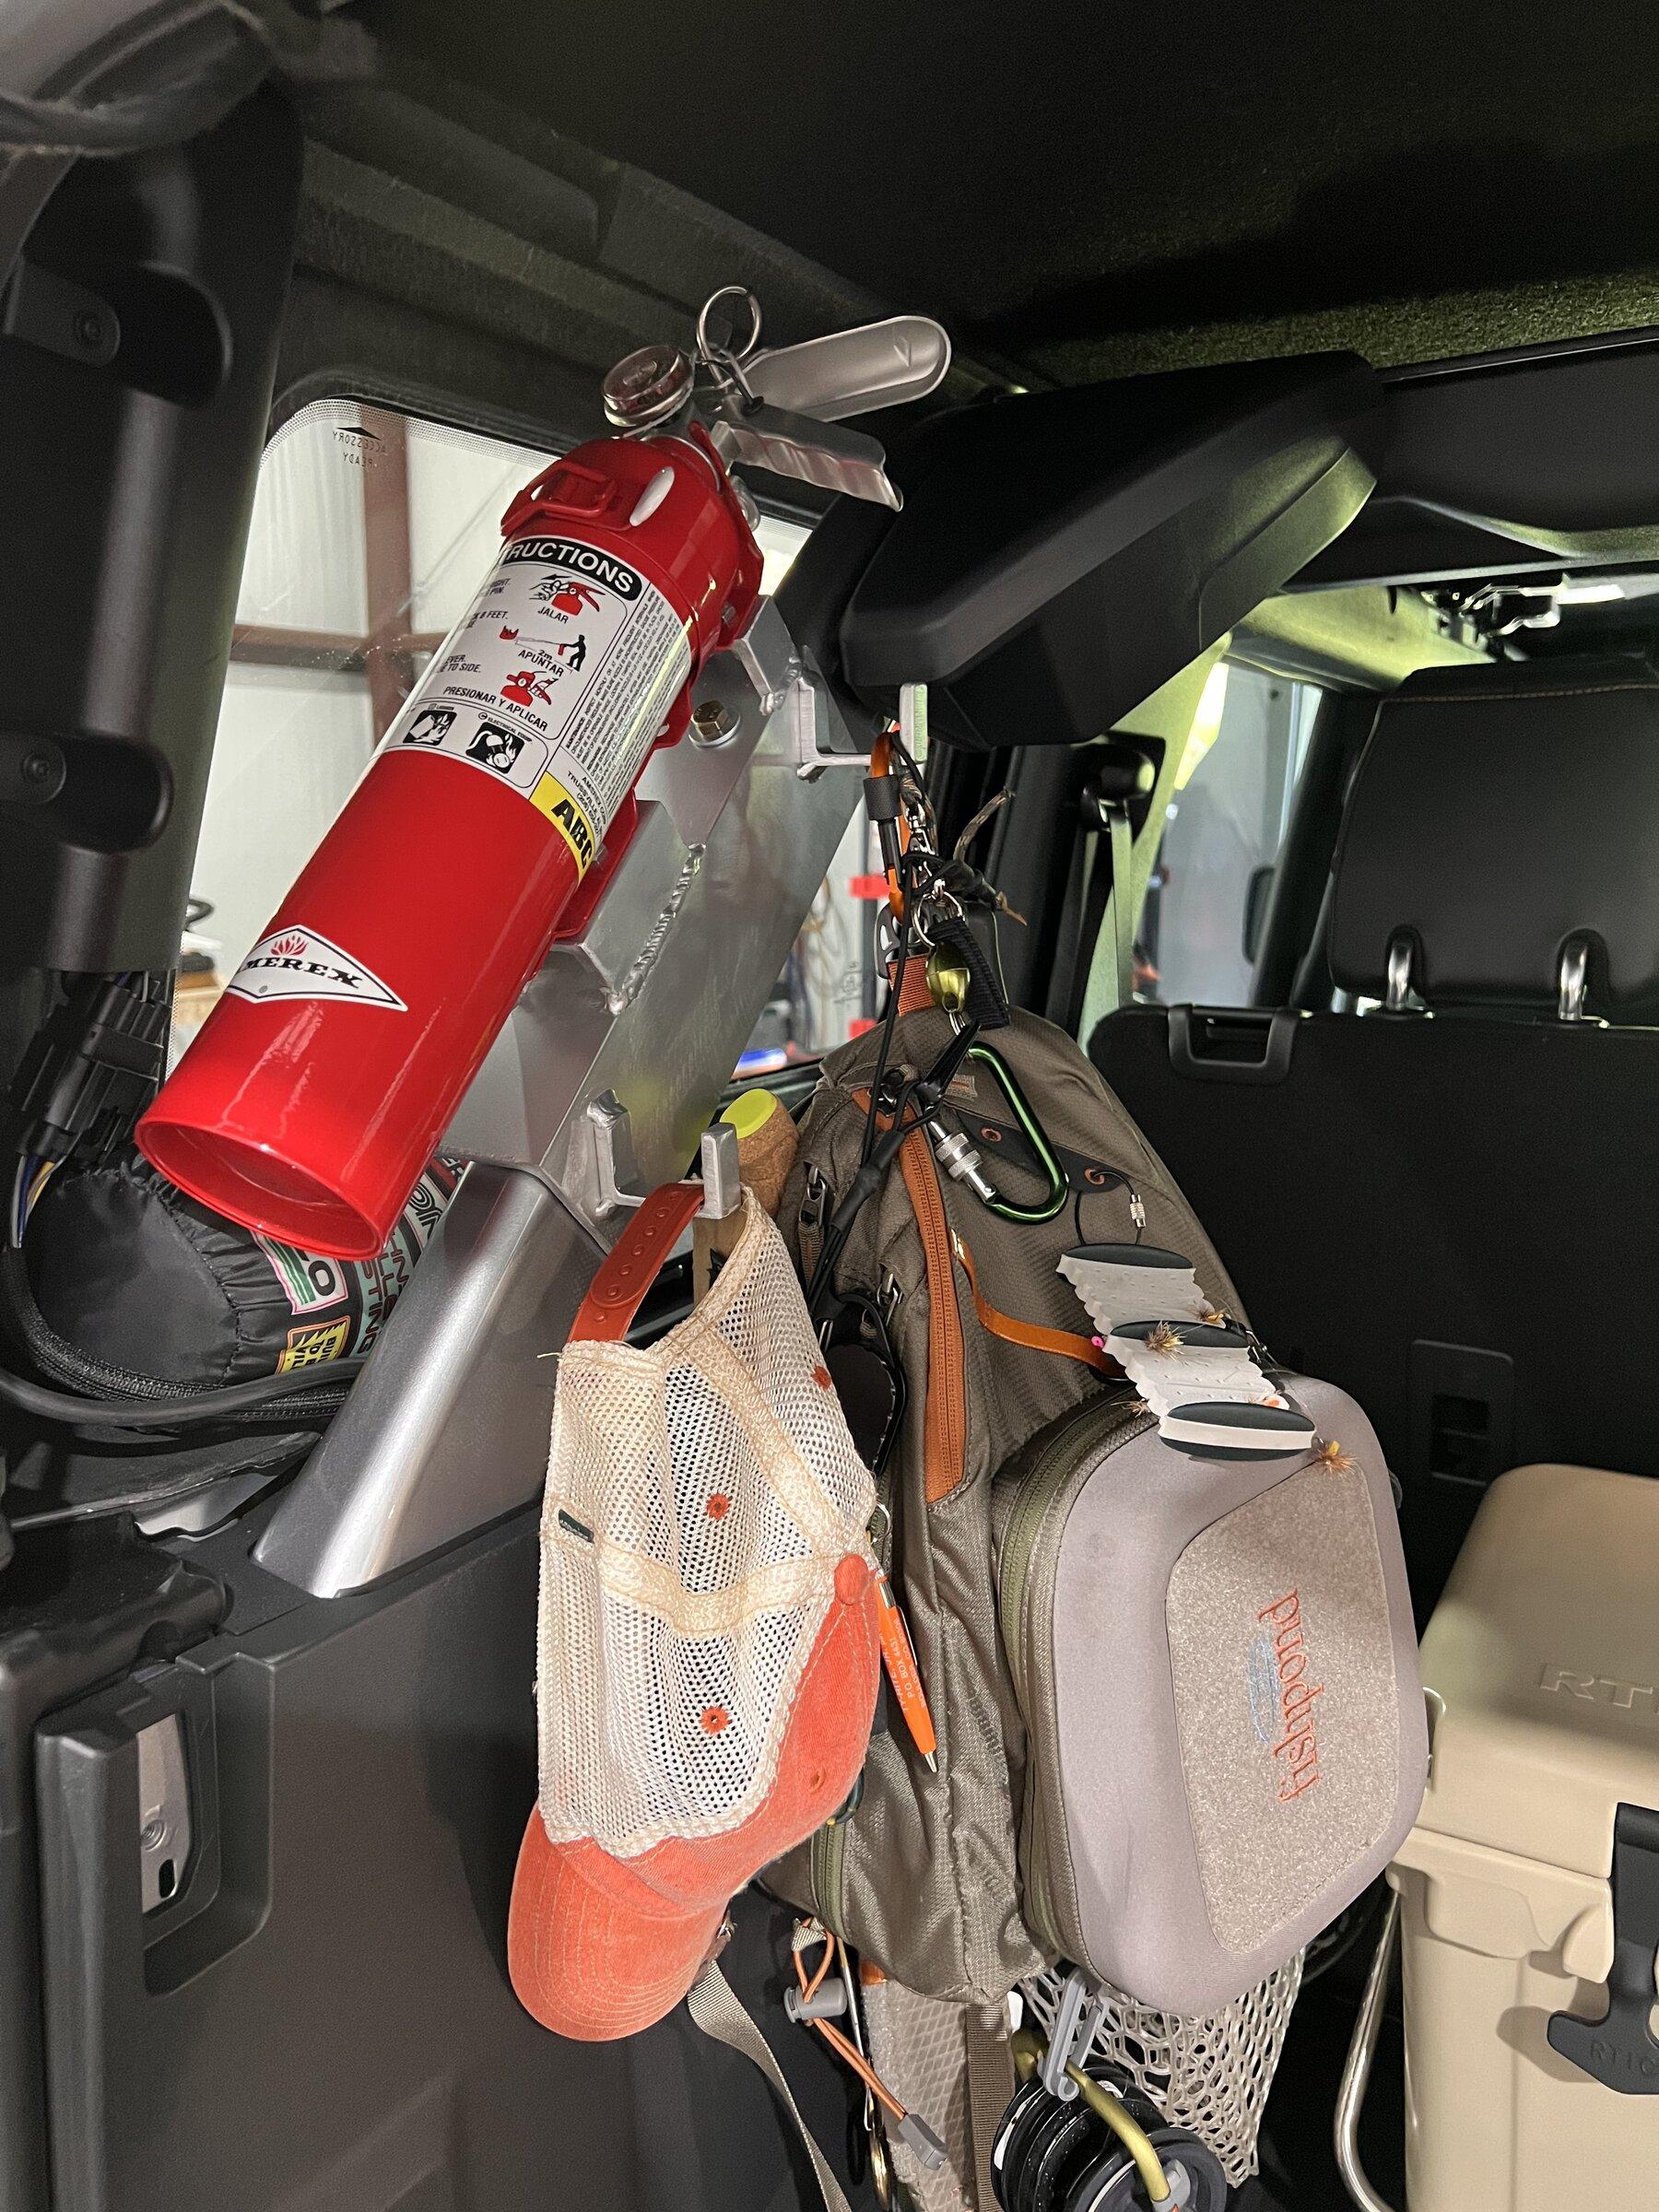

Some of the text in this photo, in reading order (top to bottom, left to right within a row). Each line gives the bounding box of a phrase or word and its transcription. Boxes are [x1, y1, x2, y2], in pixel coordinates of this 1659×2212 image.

[505, 542, 634, 593] RUCTIONS
[487, 610, 508, 619] FEET.
[538, 606, 569, 624] JALAR
[446, 654, 466, 664] EVER.
[459, 664, 481, 673] SIDE.
[518, 650, 564, 677] APUNTAR
[538, 650, 553, 661] 2m
[443, 686, 548, 732] PRESIONAR Y APLICAR
[551, 798, 593, 869] ABC
[245, 957, 362, 989] MEREX
[896, 1659, 909, 1679] BOX
[1256, 1588, 1324, 1802] fishpond
[1538, 1662, 1657, 1711] RT
